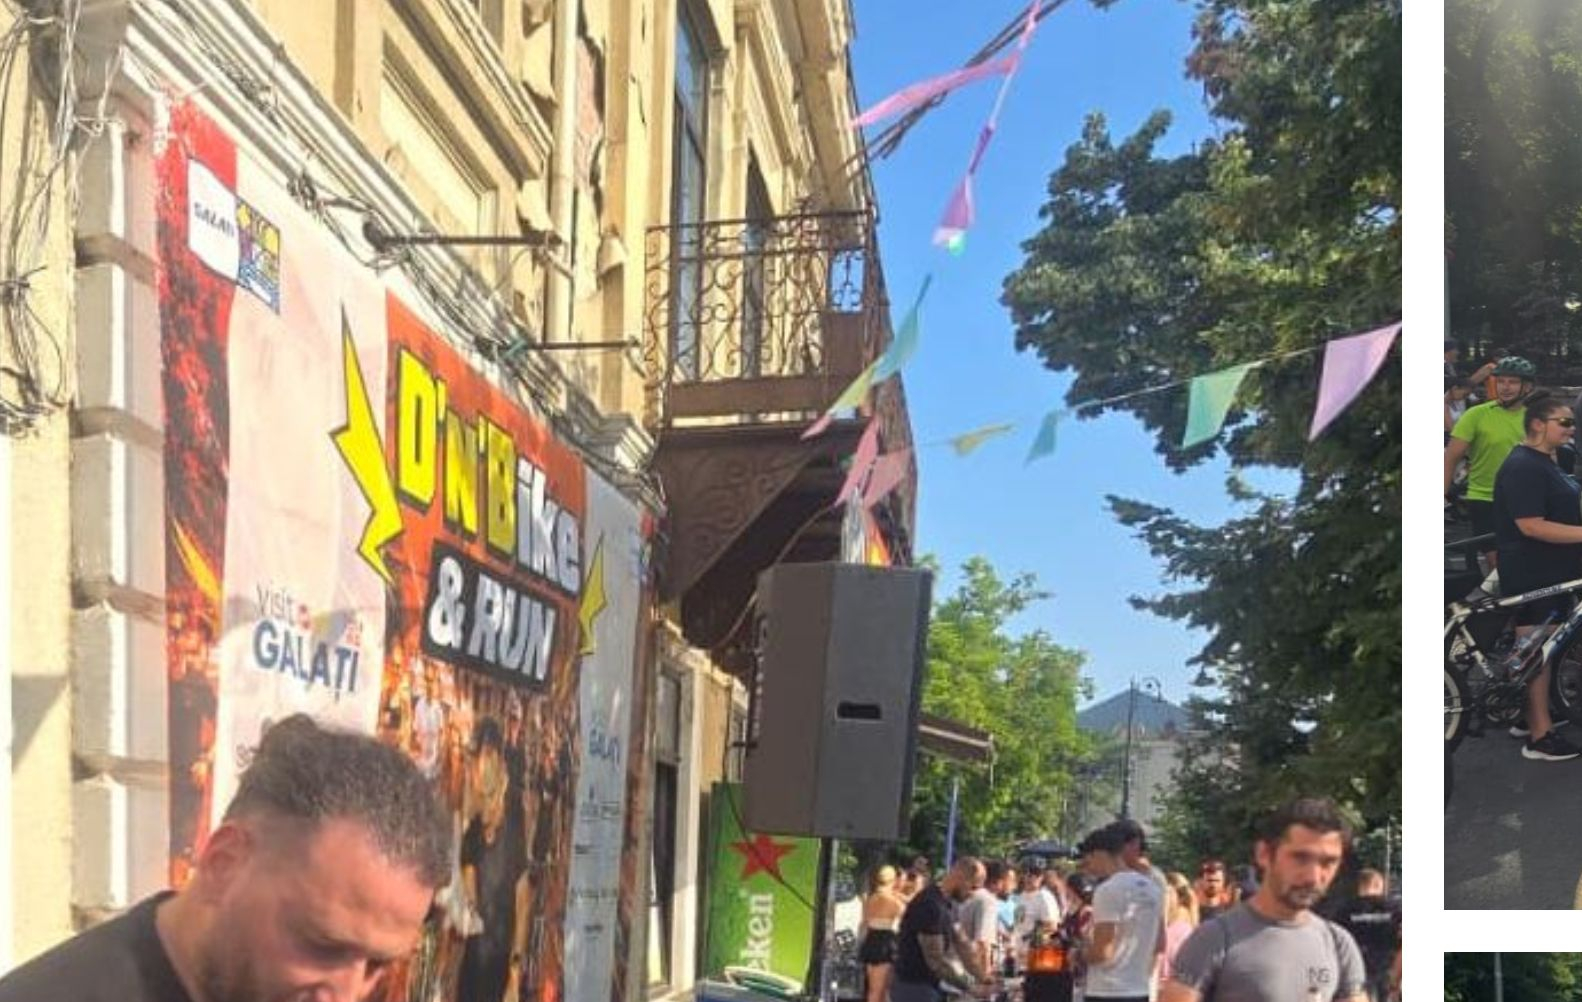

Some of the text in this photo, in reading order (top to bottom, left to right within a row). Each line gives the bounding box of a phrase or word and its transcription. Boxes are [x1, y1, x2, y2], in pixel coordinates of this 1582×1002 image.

[398, 347, 580, 595] D'N'Bike
[428, 557, 556, 681] & RUN
